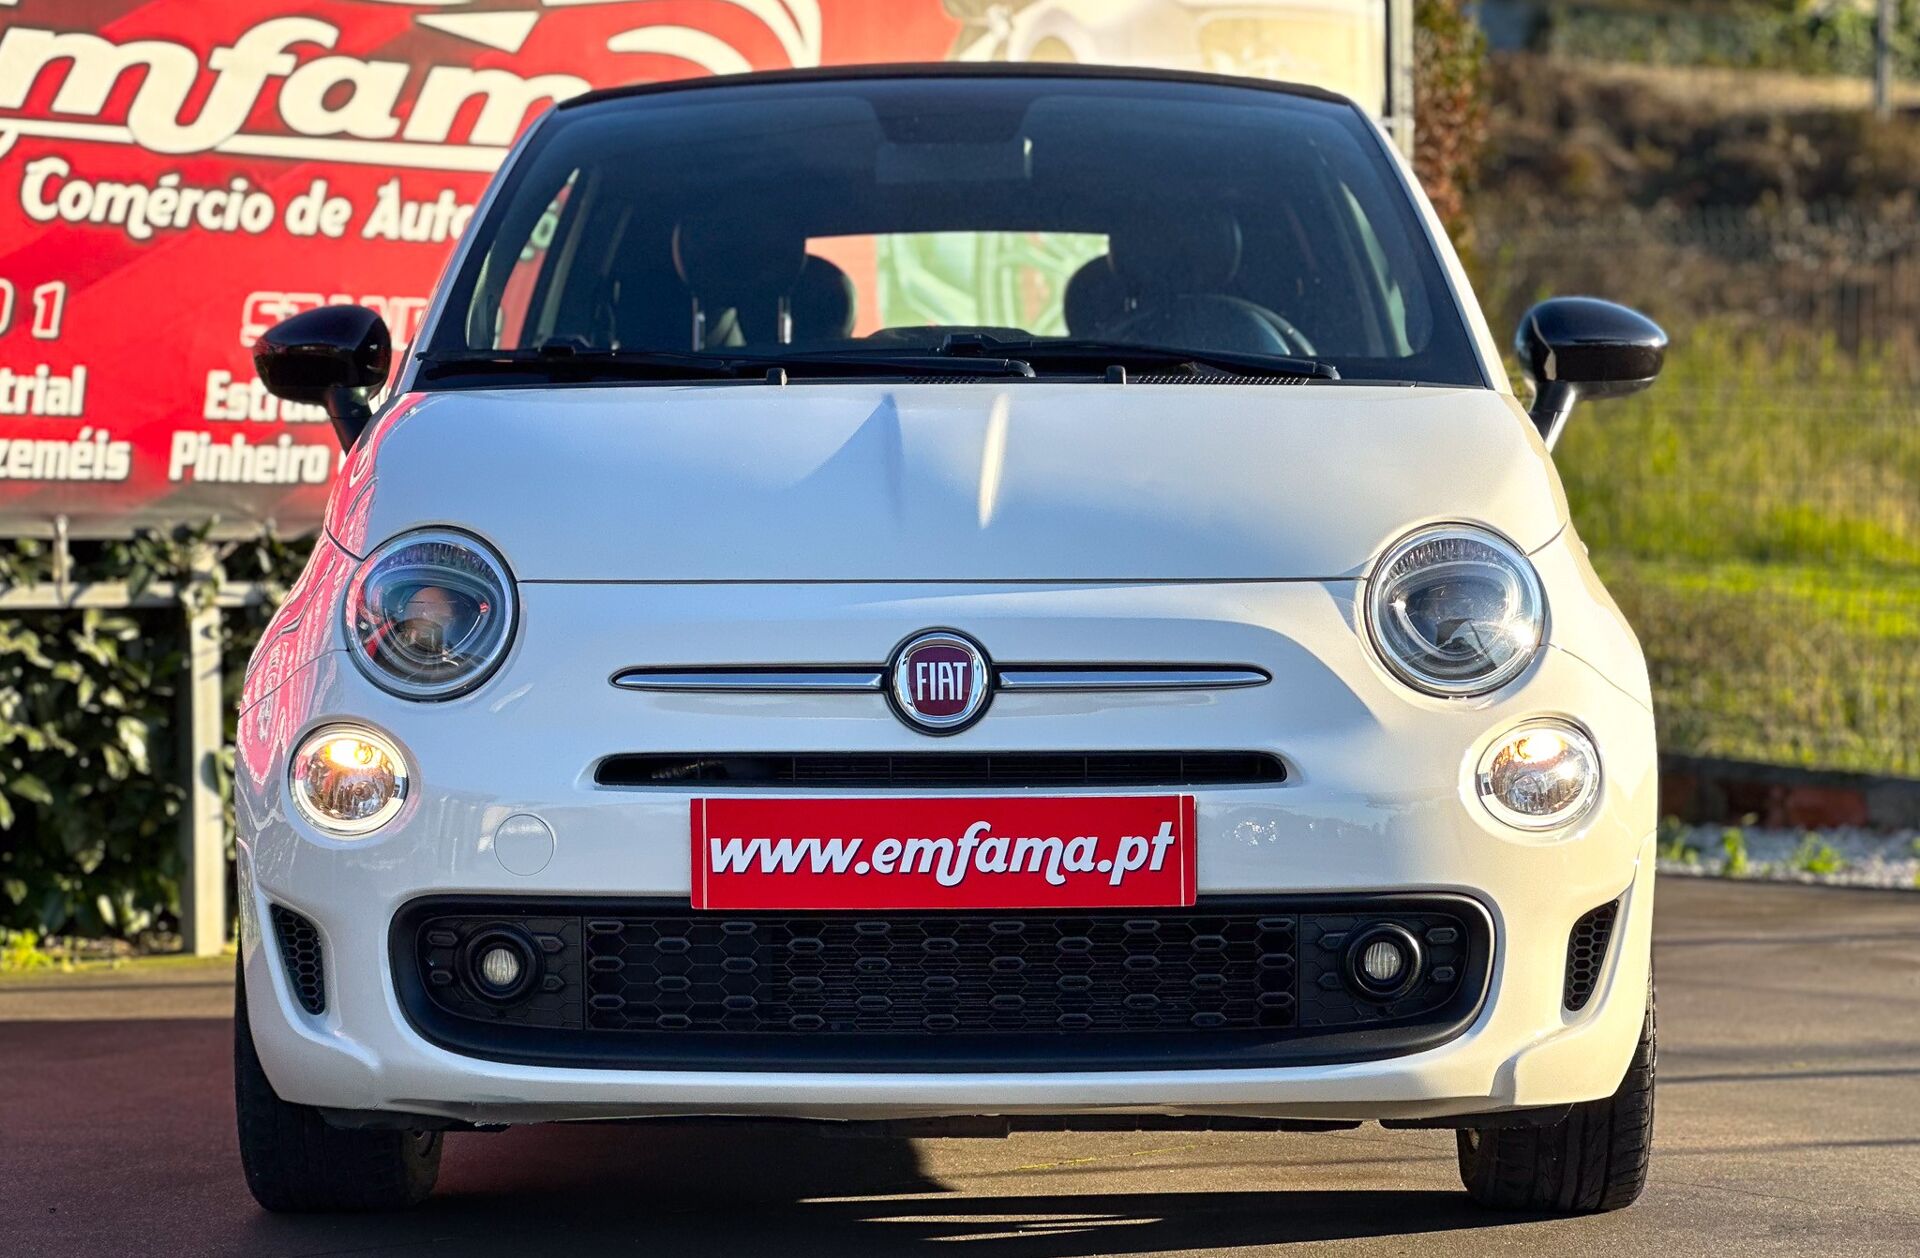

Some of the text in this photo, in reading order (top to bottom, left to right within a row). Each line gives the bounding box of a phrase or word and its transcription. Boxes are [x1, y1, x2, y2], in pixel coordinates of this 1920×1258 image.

[21, 157, 275, 239] Comércio
[285, 179, 353, 234] de
[168, 431, 330, 484] Pinheiro
[916, 662, 967, 700] FIAT
[710, 820, 1175, 886] www.emfama.pt
